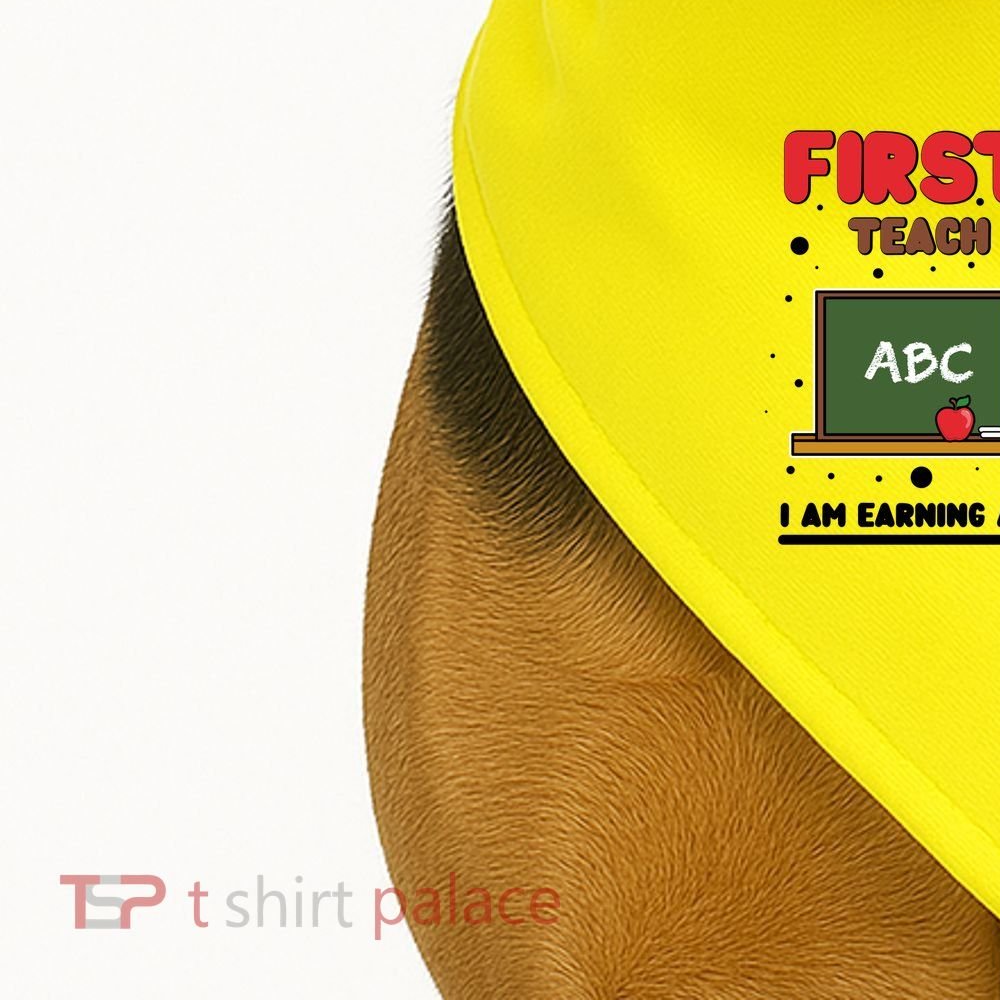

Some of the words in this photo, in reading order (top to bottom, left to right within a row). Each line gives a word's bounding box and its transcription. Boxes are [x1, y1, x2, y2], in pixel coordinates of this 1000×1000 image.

[848, 217, 991, 255] TEACH
[864, 341, 974, 383] ABC
[780, 502, 790, 527] I
[801, 502, 846, 527] AM
[857, 502, 985, 527] EARNING
